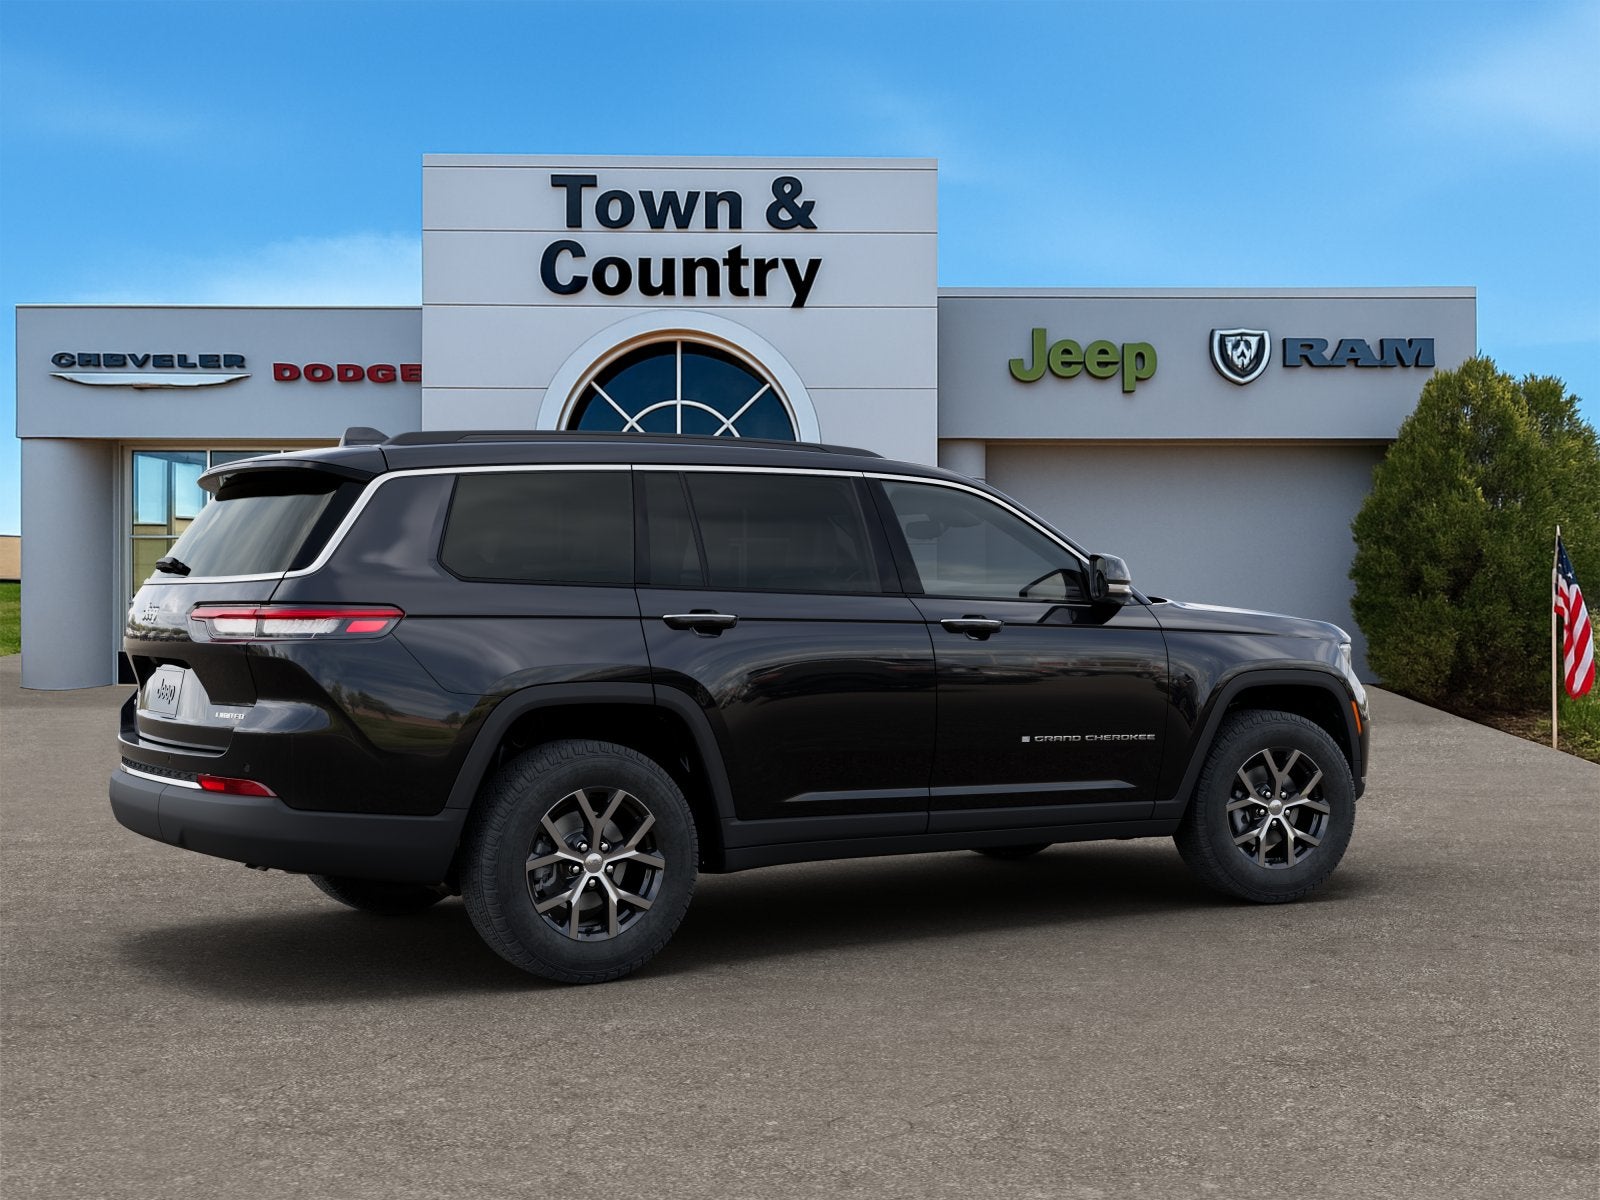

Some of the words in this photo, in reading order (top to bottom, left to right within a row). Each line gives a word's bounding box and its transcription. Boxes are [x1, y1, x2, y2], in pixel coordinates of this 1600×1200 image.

[551, 174, 742, 229] Town
[766, 176, 817, 229] &
[540, 239, 822, 308] Country
[273, 363, 422, 383] DODGE
[1009, 328, 1157, 392] Jeep
[1282, 337, 1435, 368] RAM
